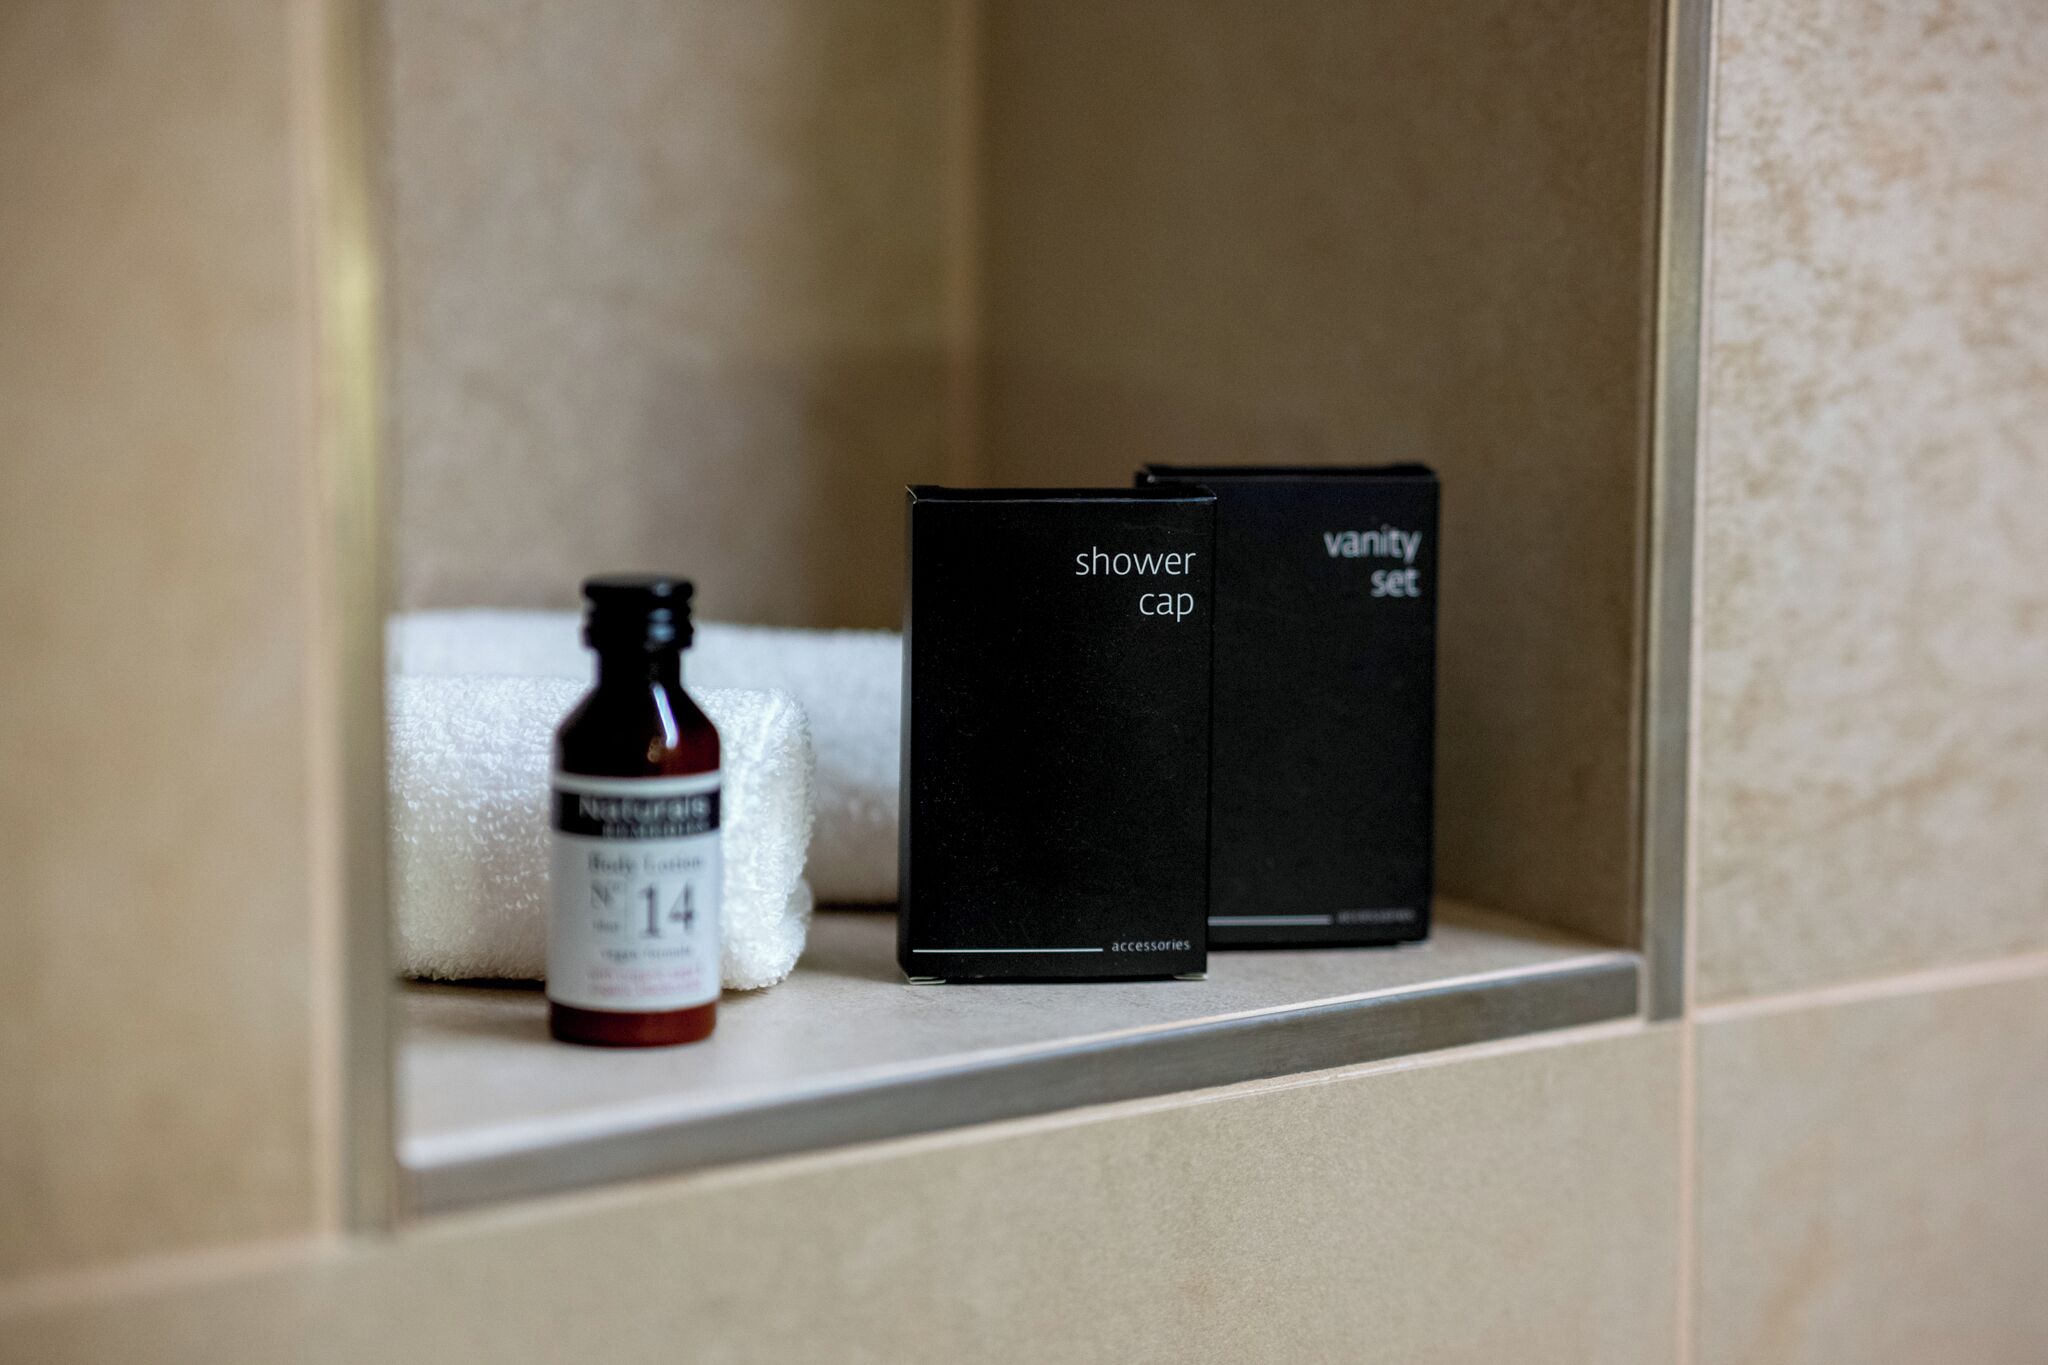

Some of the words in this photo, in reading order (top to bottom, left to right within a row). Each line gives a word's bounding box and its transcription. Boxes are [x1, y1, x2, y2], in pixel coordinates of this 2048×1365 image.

[1324, 526, 1421, 562] vanity
[1075, 546, 1196, 576] shower
[1370, 568, 1421, 597] set
[1139, 592, 1194, 622] cap
[579, 794, 710, 823] Naturals
[588, 854, 634, 876] Body
[643, 853, 703, 873] Lotion
[639, 880, 695, 938] 14
[1111, 937, 1192, 952] accessories
